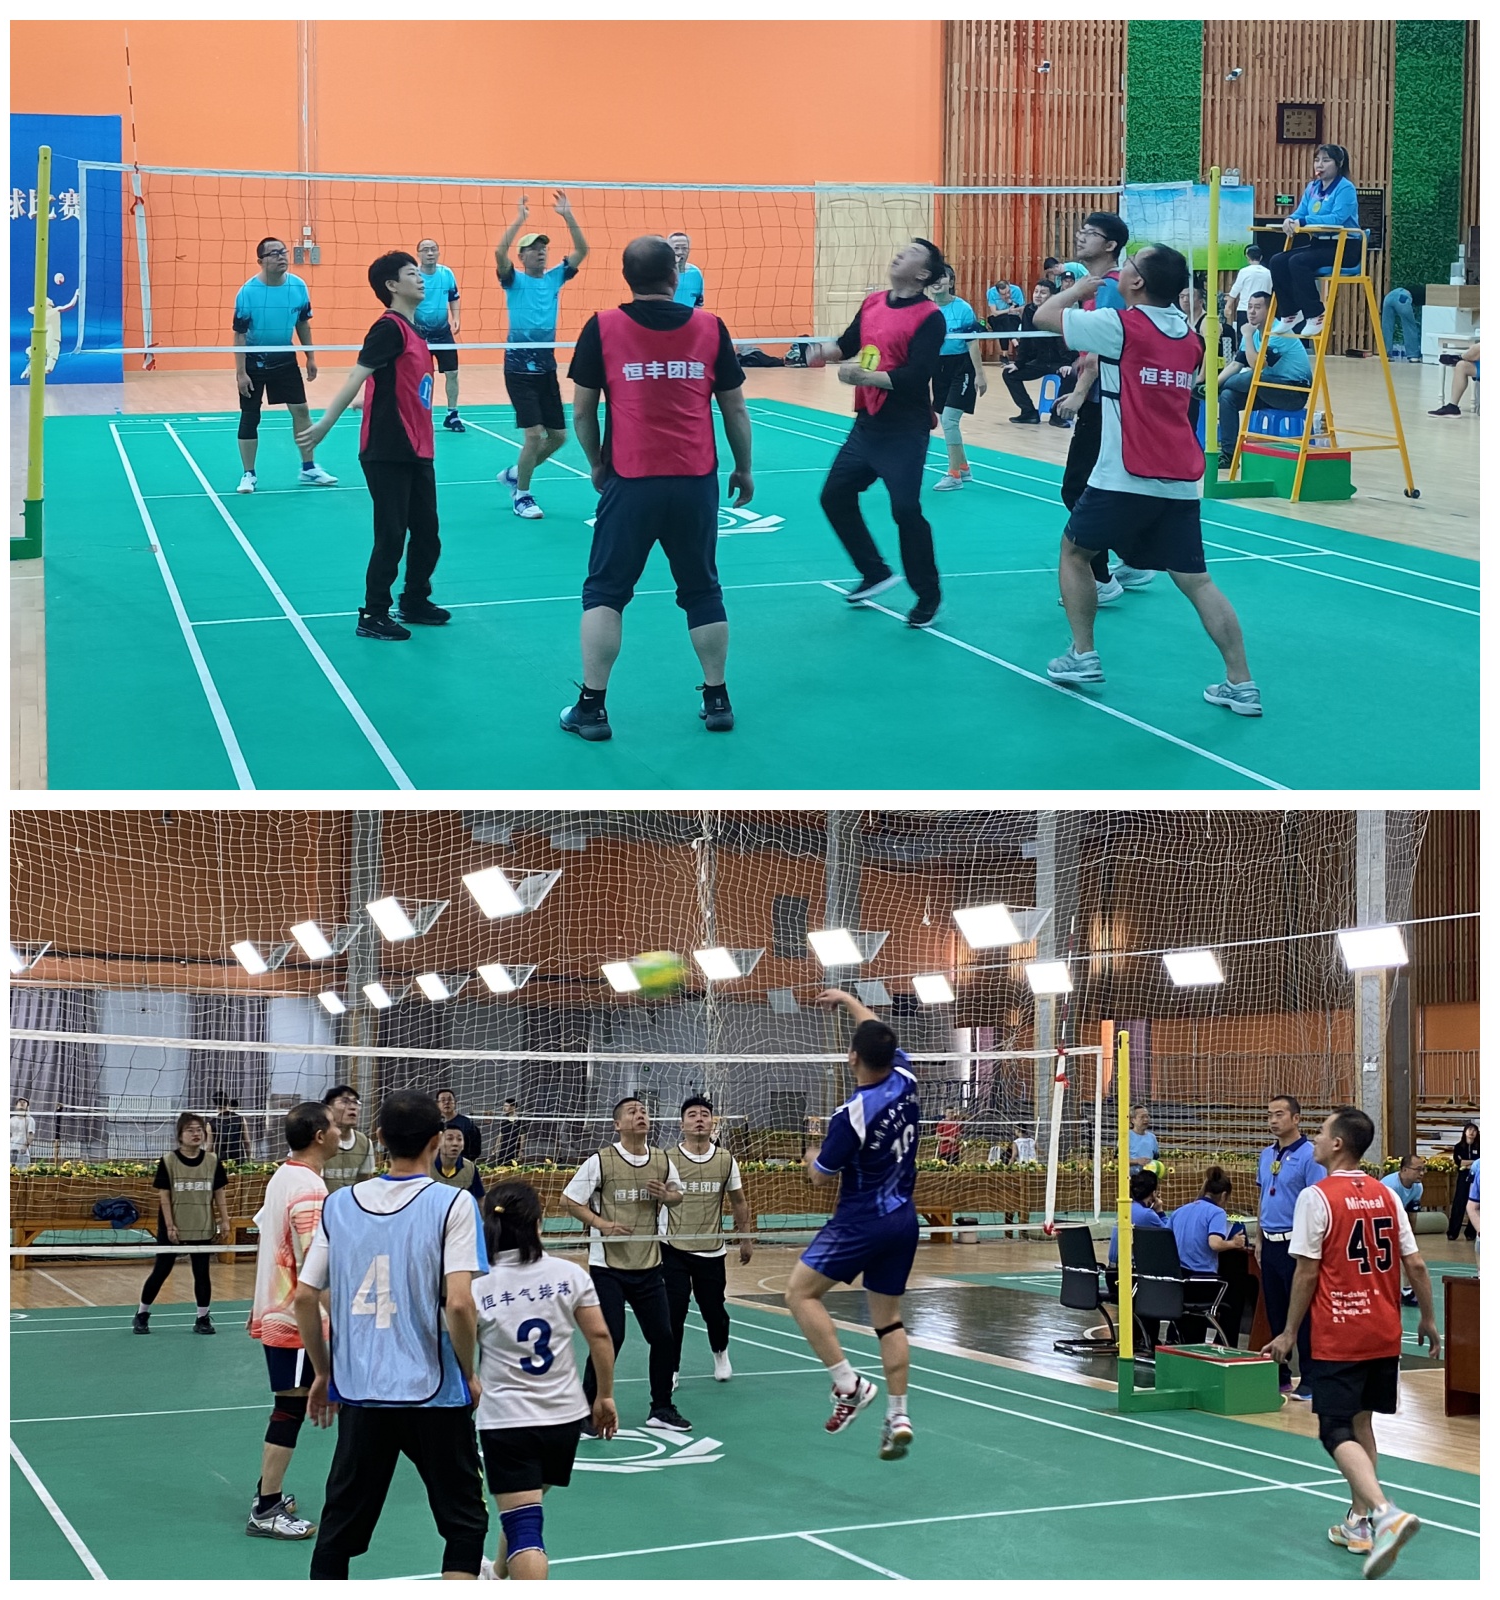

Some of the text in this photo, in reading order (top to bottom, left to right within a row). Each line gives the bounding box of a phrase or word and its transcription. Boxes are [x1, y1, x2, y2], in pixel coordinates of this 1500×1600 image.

[622, 360, 706, 381] 恒丰团建
[1344, 1194, 1386, 1211] Micheal
[1346, 1216, 1394, 1275] 45
[351, 1254, 398, 1330] 4
[516, 1317, 555, 1376] 3
